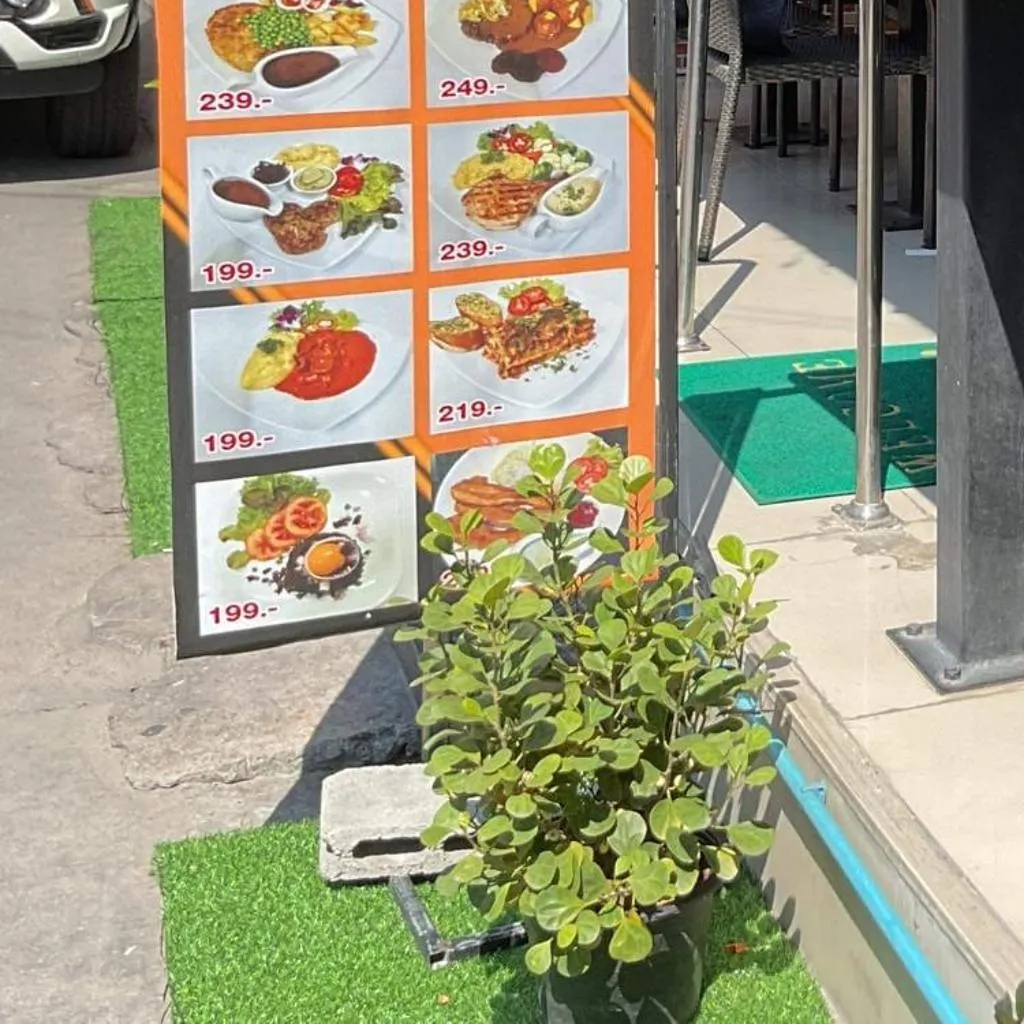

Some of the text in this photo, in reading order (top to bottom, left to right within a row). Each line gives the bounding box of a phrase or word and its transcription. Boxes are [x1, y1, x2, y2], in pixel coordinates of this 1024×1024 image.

[440, 79, 505, 98] 249.-
[199, 91, 273, 112] 239.-
[439, 240, 505, 262] 239.-
[202, 262, 273, 284] 199.-
[438, 401, 503, 423] 219.-
[203, 430, 275, 454] 199.-
[208, 602, 279, 626] 199.-
